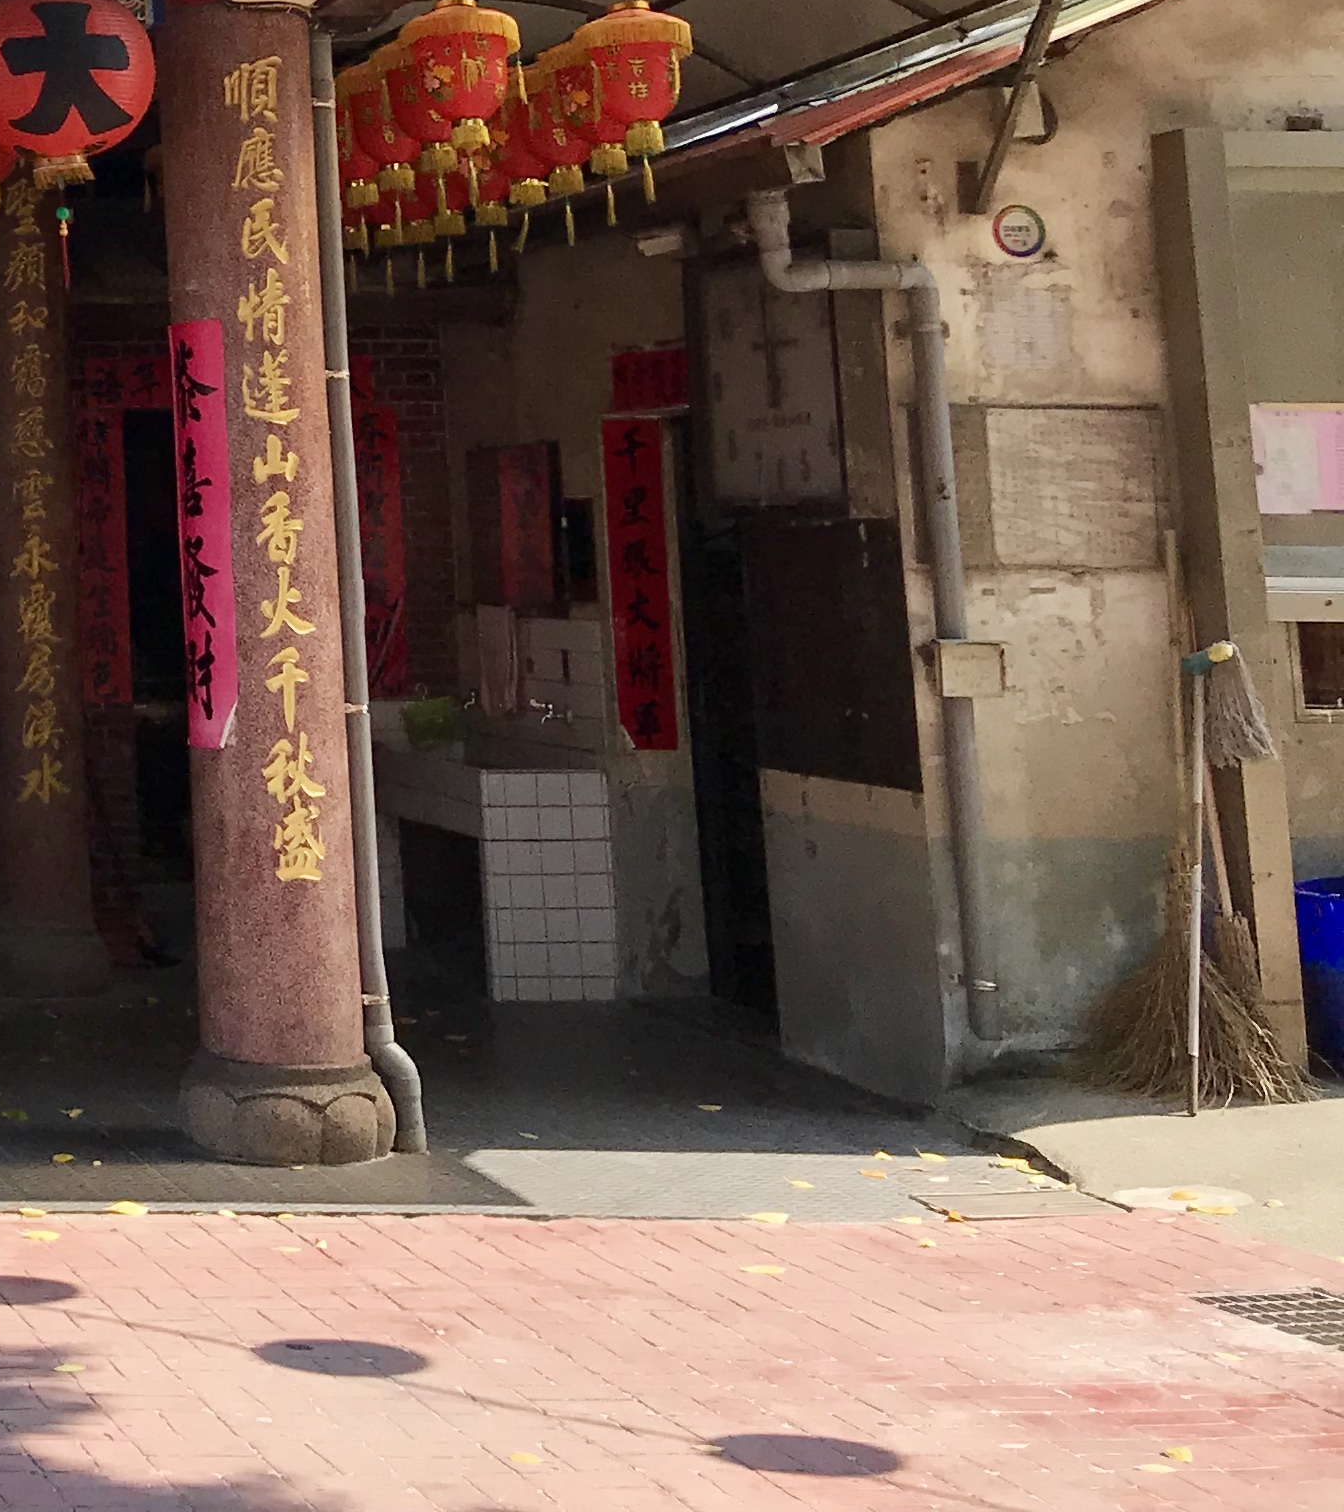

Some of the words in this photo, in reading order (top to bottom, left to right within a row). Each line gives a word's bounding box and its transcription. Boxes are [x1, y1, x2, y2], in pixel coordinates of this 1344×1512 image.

[0, 1, 134, 135] 大
[627, 56, 651, 100] 吉祥
[615, 425, 663, 746] 千里眼大將軍
